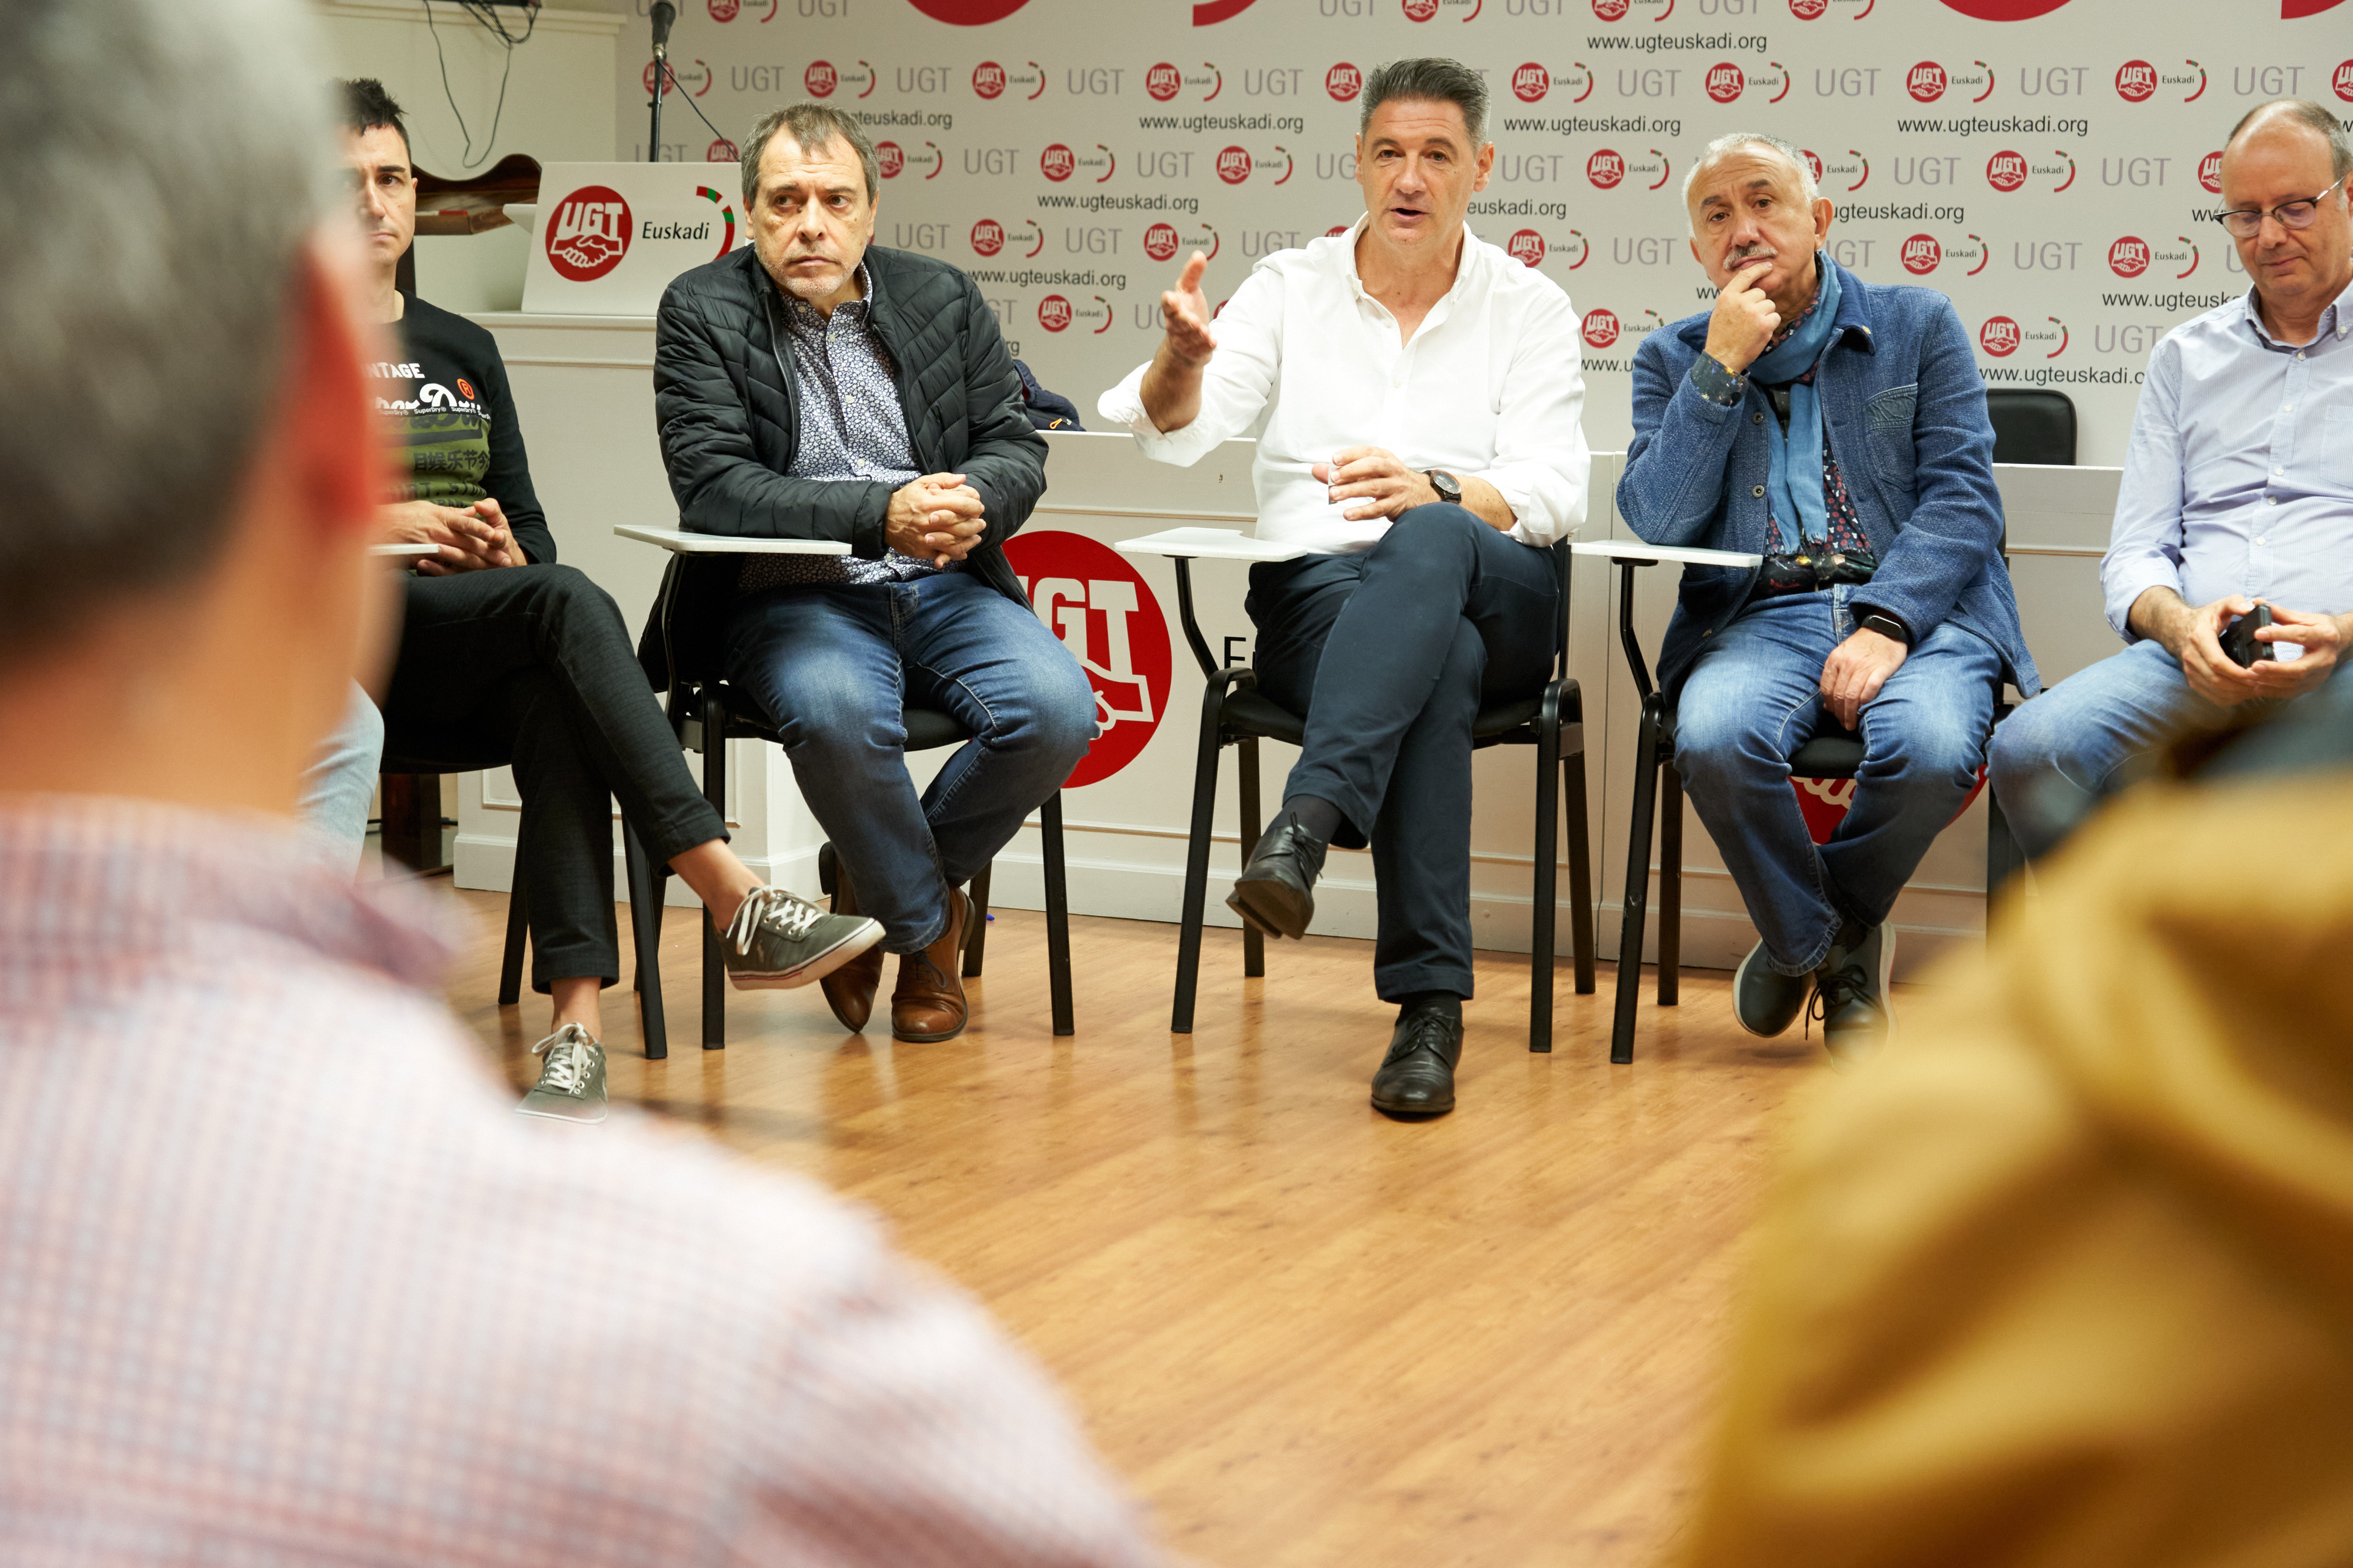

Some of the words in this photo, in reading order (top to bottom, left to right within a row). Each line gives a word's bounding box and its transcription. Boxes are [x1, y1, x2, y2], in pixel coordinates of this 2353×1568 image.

[1588, 33, 1767, 54] www.ugteuskadi.org
[732, 66, 784, 92] UGT
[808, 66, 835, 81] UGT
[897, 67, 951, 93] UGT
[976, 68, 1001, 83] UGT
[1009, 75, 1036, 84] Euskadi
[1068, 69, 1125, 95] UGT
[1150, 69, 1177, 84] UGT
[1184, 76, 1212, 85] Euskadi
[1244, 69, 1304, 96] UGT
[1331, 69, 1355, 84] UGT
[1517, 69, 1547, 84] UGT
[1554, 77, 1582, 85] Euskadi
[1618, 69, 1681, 97] UGT
[1709, 69, 1739, 85] UGT
[1749, 77, 1779, 85] Euskadi
[1815, 69, 1881, 96] UGT
[1911, 68, 1943, 84] UGT
[1952, 76, 1983, 85] Euskadi
[2021, 68, 2089, 96] UGT
[2121, 67, 2152, 83] UGT
[2162, 75, 2195, 84] Euskadi
[2234, 66, 2305, 95] UGT
[1139, 114, 1304, 133] www.ugteuskadi.org
[1505, 116, 1681, 136] www.ugteuskadi.org
[1898, 116, 2088, 136] www.ugteuskadi.org
[964, 149, 1019, 175] UGT
[1044, 151, 1071, 165] UGT
[1078, 158, 1106, 166] Euskadi
[1137, 151, 1195, 178] UGT
[1222, 153, 1248, 167] UGT
[1255, 160, 1283, 168] Euskadi
[1317, 154, 1357, 179] UG
[1502, 155, 1563, 182] UGT
[1592, 156, 1621, 171] UGT
[1629, 164, 1659, 172] Euskadi
[1992, 158, 2022, 173] UGT
[2032, 165, 2064, 175] Euskadi
[1827, 165, 1858, 174] Euskadi
[1894, 157, 1961, 185] UGT
[2102, 158, 2172, 186] UGT
[1038, 194, 1198, 214] www.ugteuskadi.org
[1467, 199, 1566, 220] euskadi.org
[1833, 203, 1964, 223] ugteuskadi.org
[557, 202, 624, 237] UGT
[642, 221, 710, 240] Euskadi
[896, 223, 950, 249] UGT
[975, 225, 1001, 241] UGT
[1008, 233, 1035, 242] Euskadi
[1066, 227, 1122, 255] UGT
[1148, 230, 1175, 245] UGT
[1182, 238, 1209, 246] Euskadi
[1242, 231, 1301, 257] UGT
[1513, 235, 1541, 252] UGT
[1549, 244, 1578, 253] Euskadi
[1614, 237, 1677, 265] UGT
[1906, 241, 1937, 256] UGT
[1945, 249, 1977, 258] Euskadi
[2116, 243, 2145, 259] UGT
[2155, 252, 2187, 261] Euskadi
[2014, 242, 2082, 270] UGT
[1042, 301, 1068, 316] UGT
[1075, 309, 1104, 318] Euskadi
[2102, 292, 2241, 311] www.ugteusk
[1587, 315, 1615, 331] UGT
[1987, 322, 2016, 339] UGT
[2025, 332, 2057, 341] Euskadi
[2095, 325, 2164, 353] UGT
[367, 362, 425, 378] NTAGE
